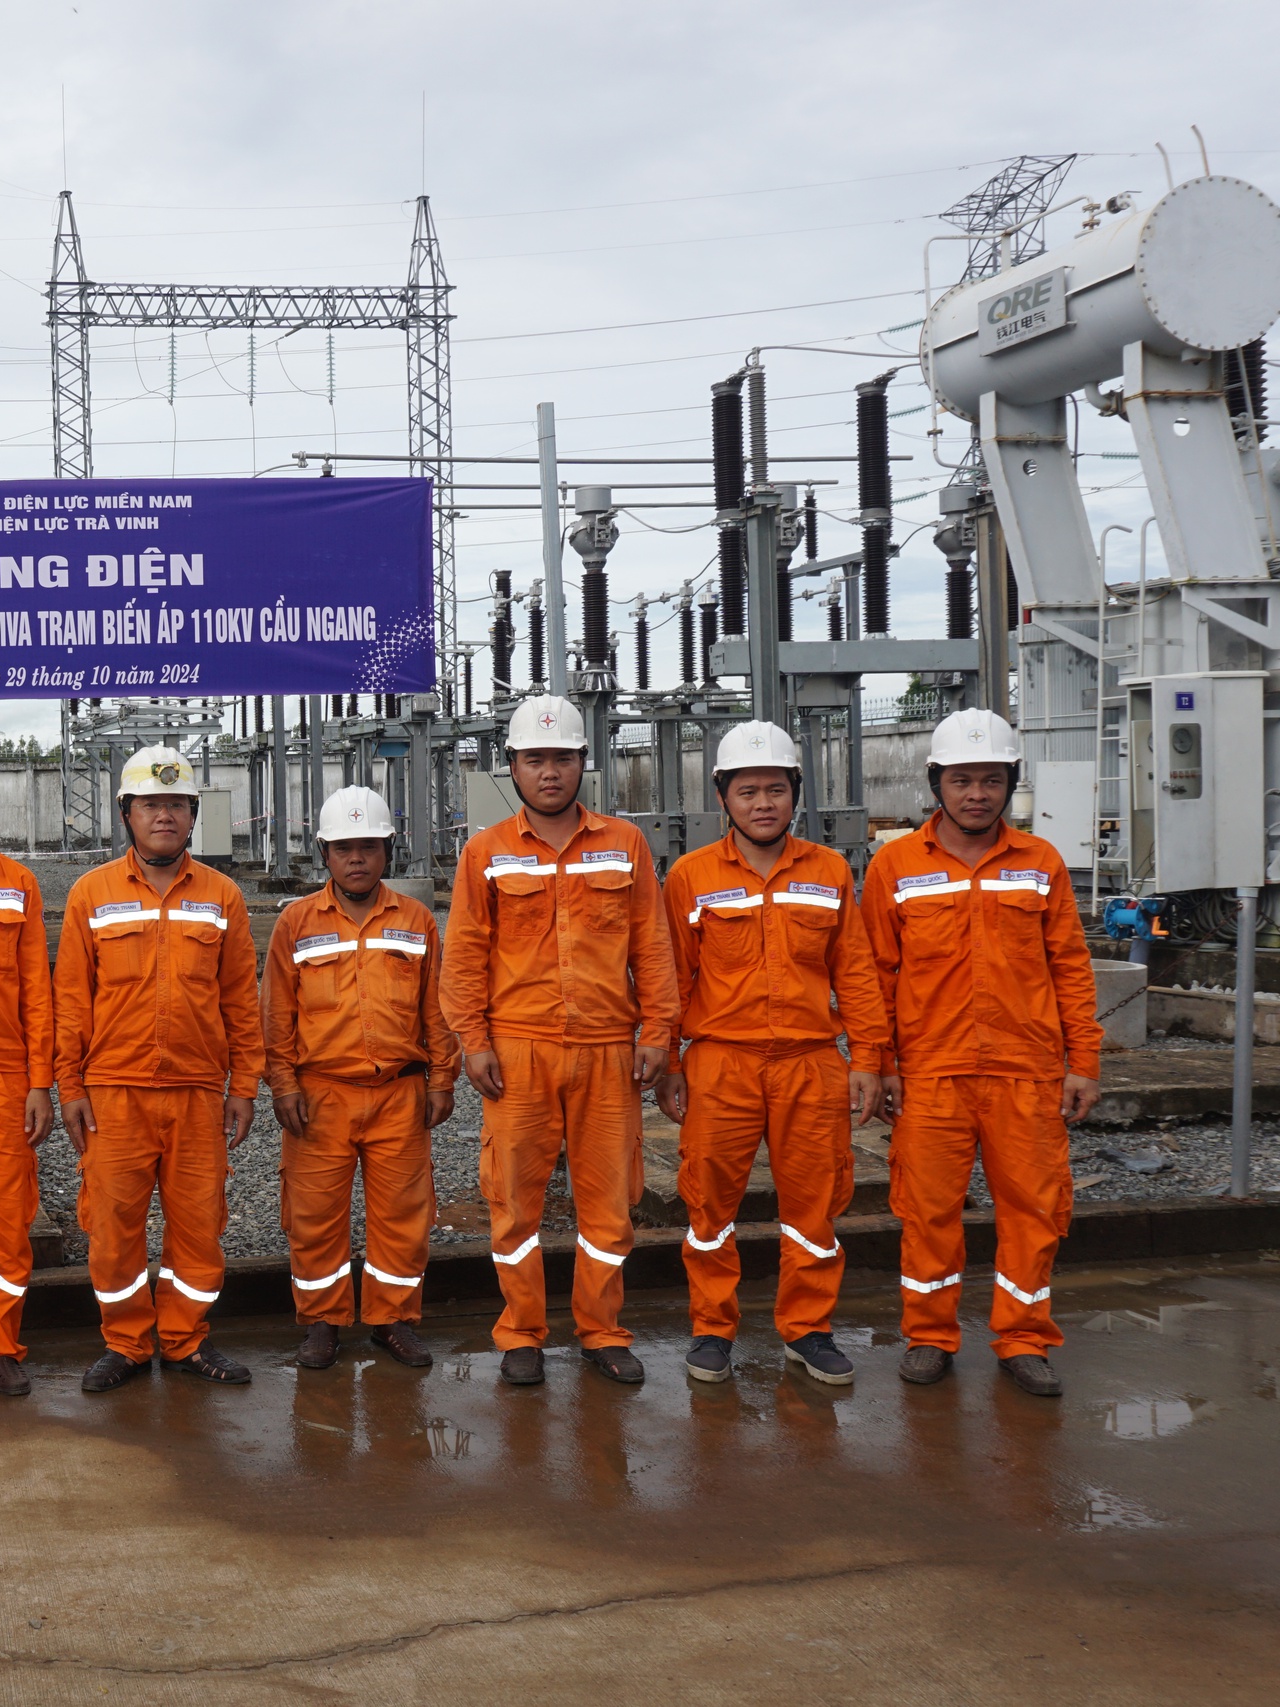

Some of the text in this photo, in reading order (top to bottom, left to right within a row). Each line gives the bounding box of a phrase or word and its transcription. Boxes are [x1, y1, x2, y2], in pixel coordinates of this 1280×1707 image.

[987, 276, 1053, 324] QRE
[996, 310, 1046, 339] 钱江电气
[3, 494, 48, 513] ĐIỆN
[53, 494, 89, 512] LỰC
[94, 491, 144, 509] MIỀN
[148, 495, 193, 509] NAM
[33, 516, 69, 534] LỰC
[74, 514, 111, 531] TRÀ
[114, 516, 159, 530] VINH
[85, 546, 204, 594] ĐIỆN
[37, 609, 97, 654] TRẠM
[102, 597, 151, 645] BIẾN
[156, 601, 185, 644] ÁP
[190, 607, 254, 644] 110KV
[259, 594, 301, 643] CẦU
[306, 605, 376, 643] NGANG
[4, 666, 27, 687] 29
[31, 665, 86, 691] tháng
[90, 665, 111, 685] 10
[115, 665, 155, 685] năm
[159, 663, 200, 684] 2024
[596, 852, 625, 860] EVNSPC
[805, 885, 835, 896] EVNSPC
[195, 905, 221, 914] EVNSPC
